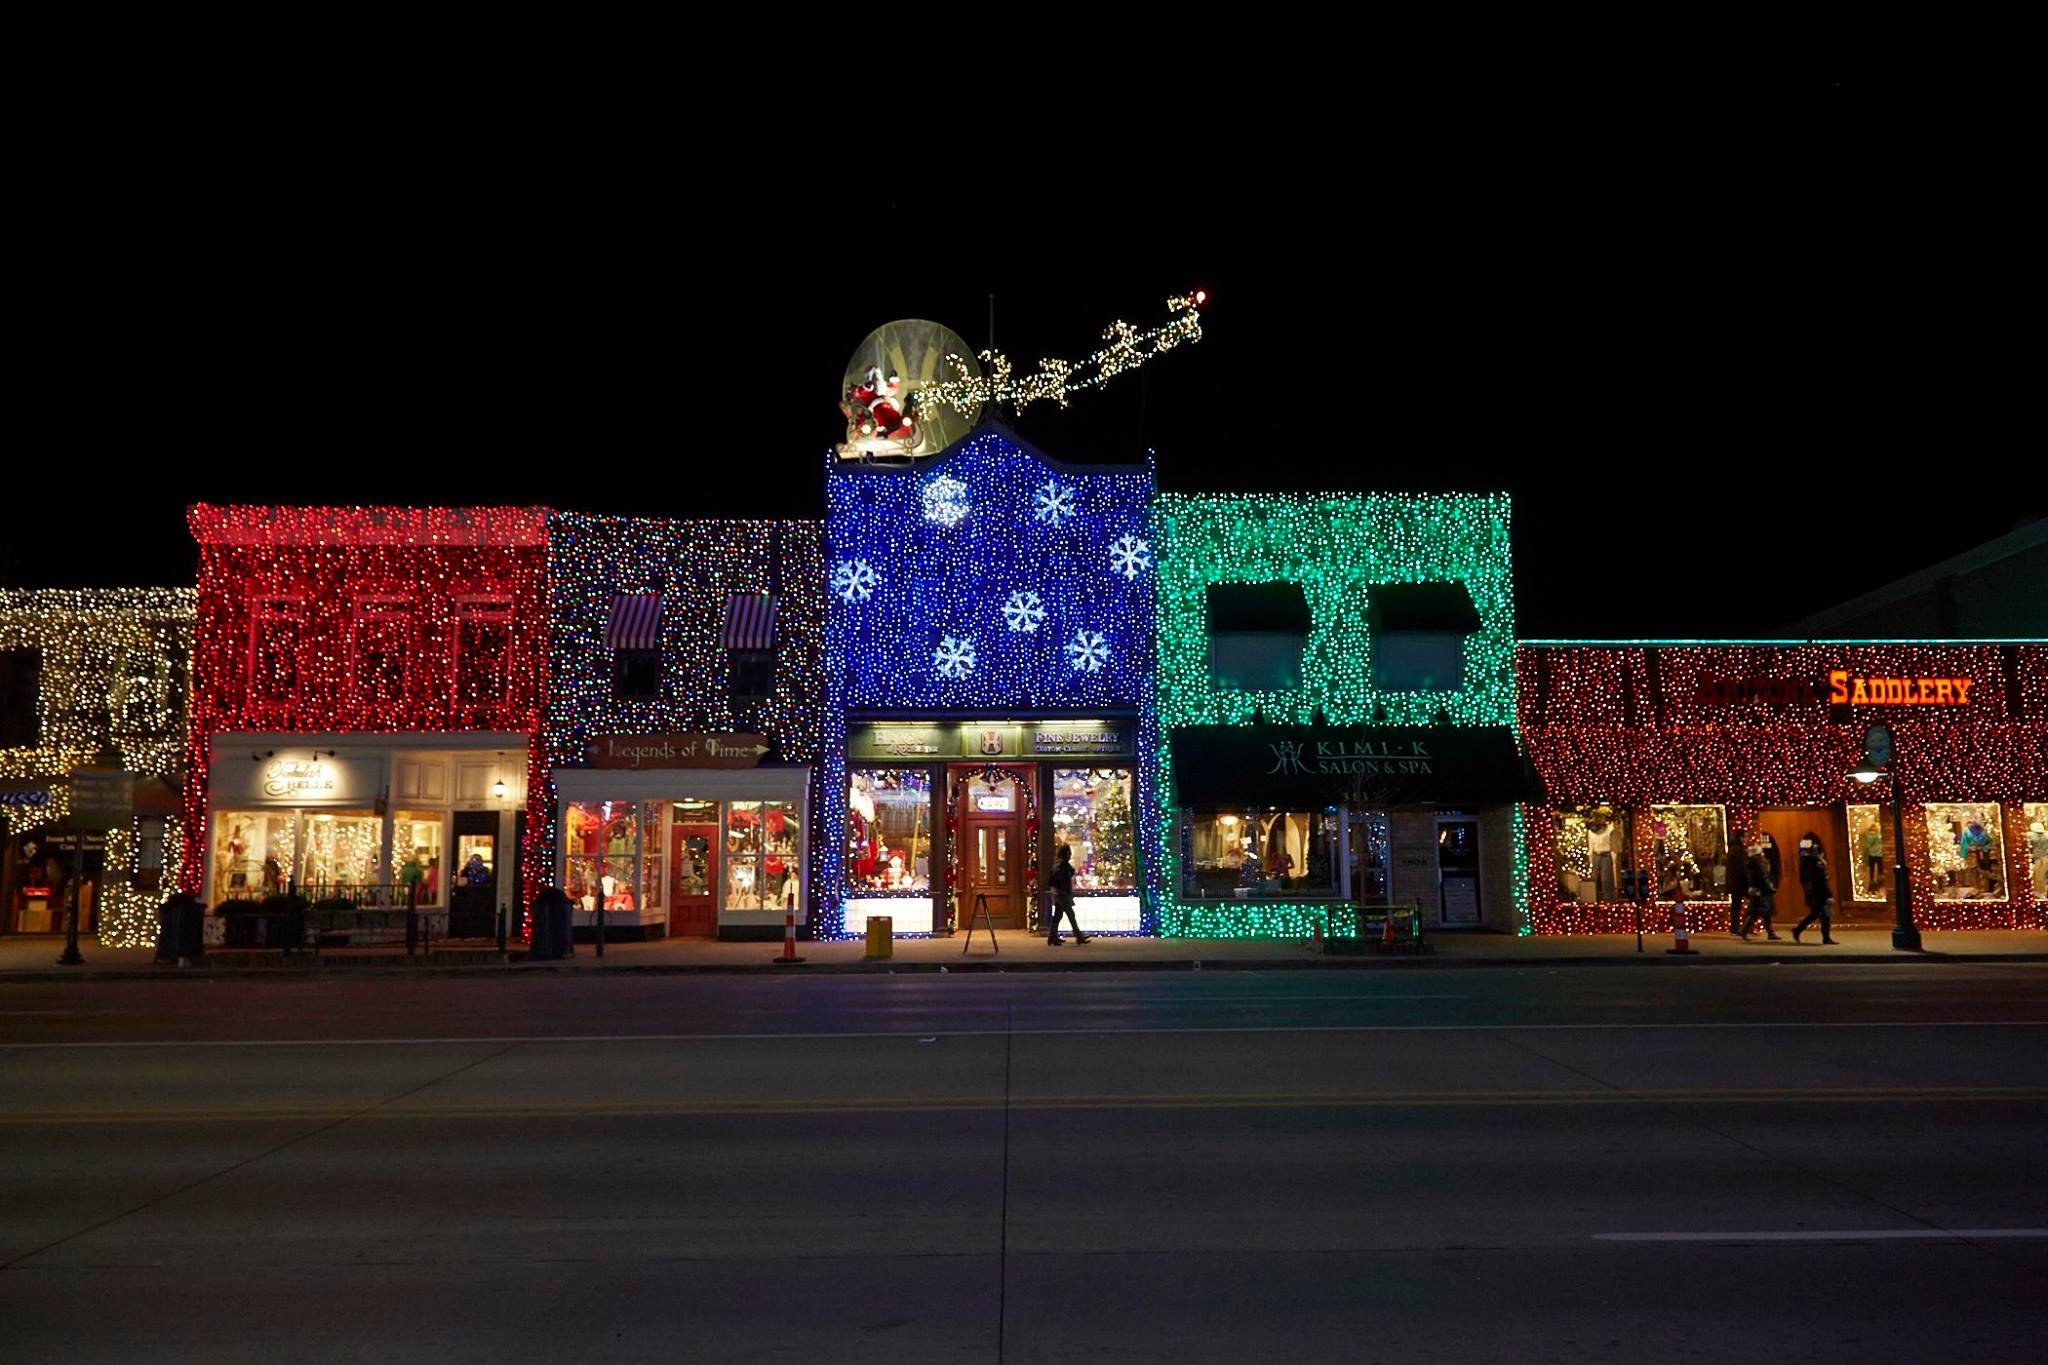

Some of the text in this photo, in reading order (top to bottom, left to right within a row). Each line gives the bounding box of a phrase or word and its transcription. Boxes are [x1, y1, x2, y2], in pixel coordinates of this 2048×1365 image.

[1829, 669, 1971, 705] SADDLERY
[1035, 732, 1119, 743] FINE JEWELRY
[608, 738, 750, 767] Legends of Time
[1319, 761, 1433, 775] SALON & SPA
